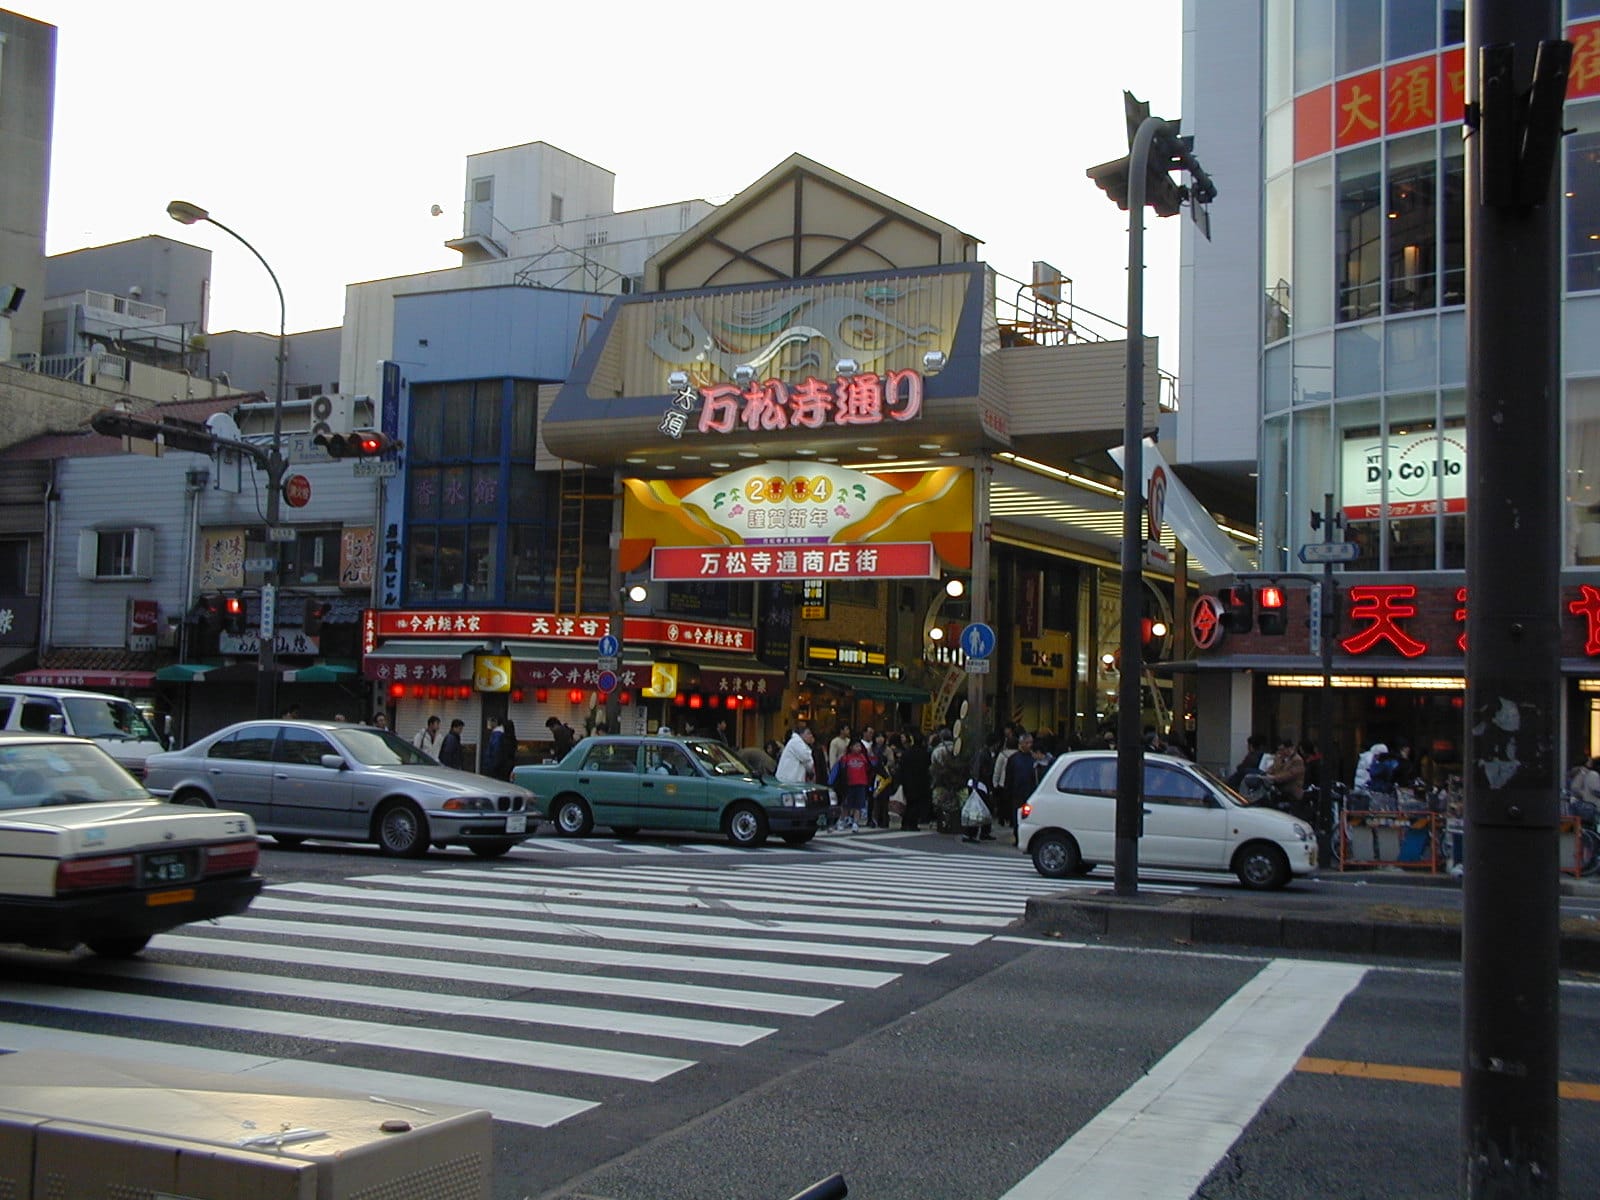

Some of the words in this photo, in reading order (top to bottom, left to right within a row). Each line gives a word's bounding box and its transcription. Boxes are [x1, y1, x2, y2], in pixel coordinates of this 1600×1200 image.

[658, 386, 697, 439] 大須
[699, 369, 922, 433] 万松寺通り
[747, 509, 828, 529] 謹賀新年
[701, 549, 877, 575] 万松寺通商店街
